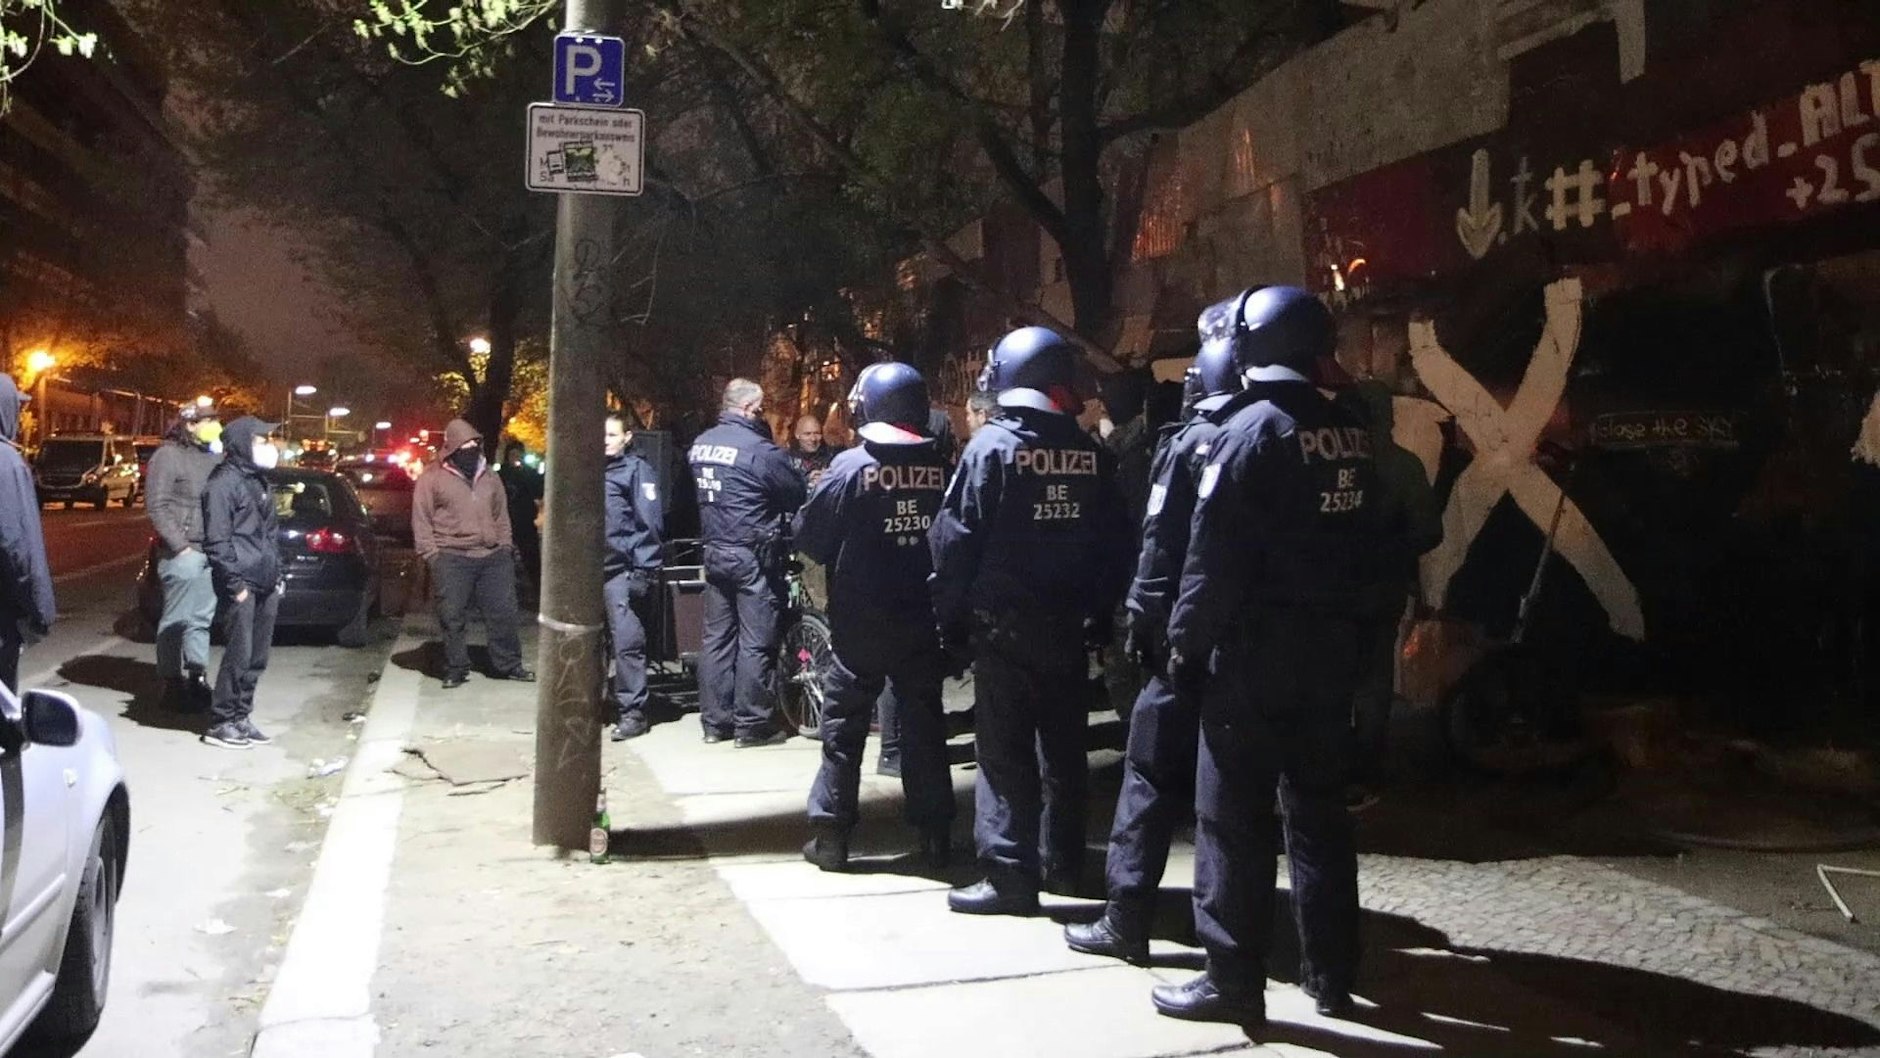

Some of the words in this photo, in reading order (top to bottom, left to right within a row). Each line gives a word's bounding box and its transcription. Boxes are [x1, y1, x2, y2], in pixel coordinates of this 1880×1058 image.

[565, 44, 603, 96] P
[539, 114, 554, 123] mit
[559, 114, 609, 126] Parkschein
[612, 117, 632, 128] oder
[688, 444, 738, 466] POLIZEI
[1015, 449, 1097, 476] POLIZEI
[863, 465, 945, 490] POLIZEI
[1337, 467, 1356, 488] BE
[1046, 485, 1067, 501] BE
[896, 499, 918, 515] BE
[1033, 504, 1080, 520] 25232
[884, 516, 931, 533] 25230
